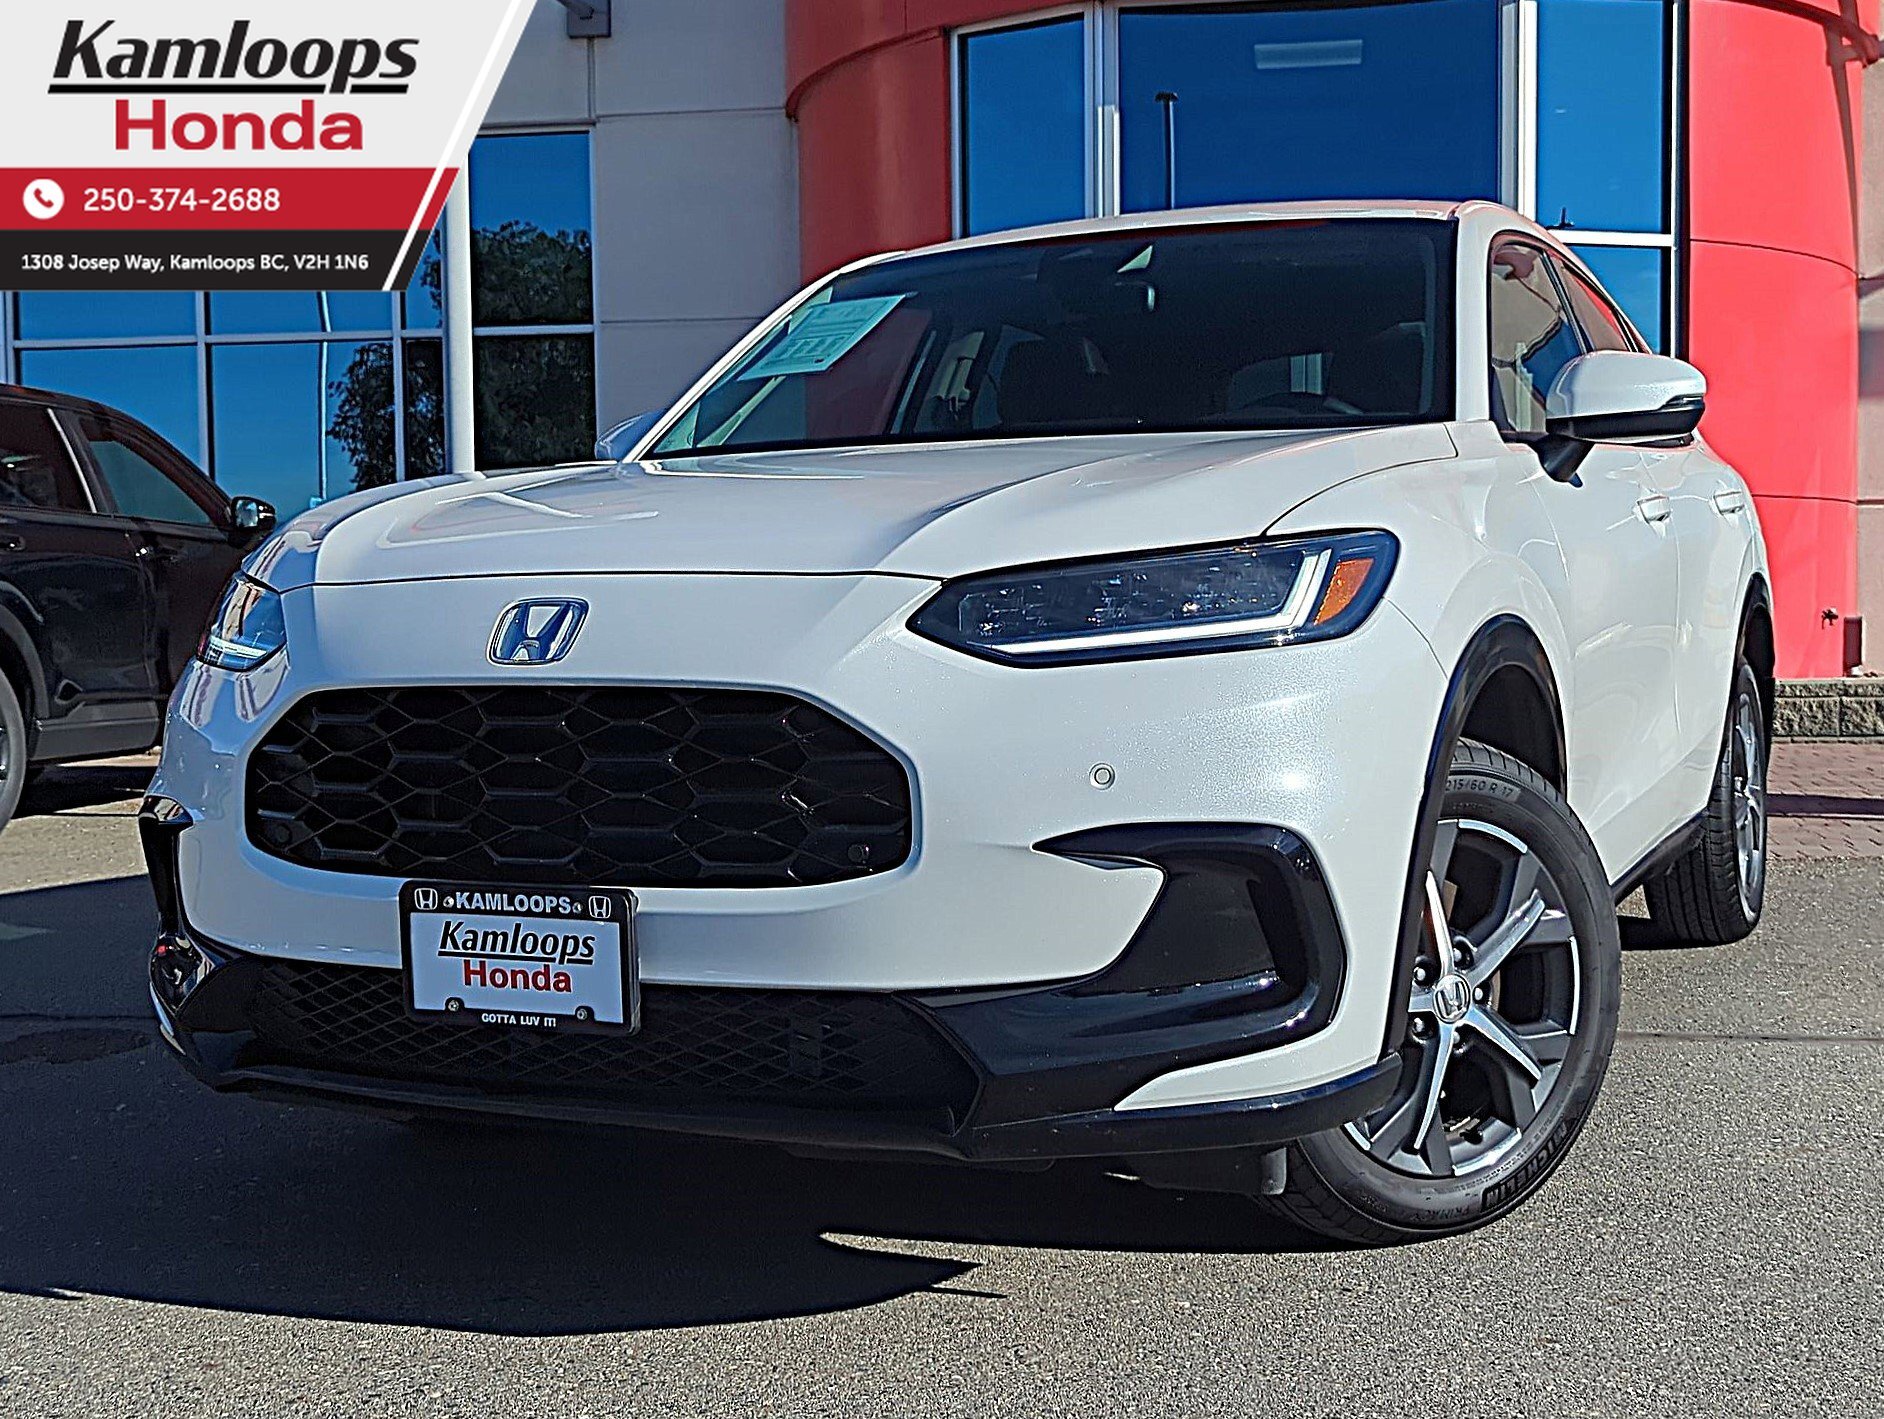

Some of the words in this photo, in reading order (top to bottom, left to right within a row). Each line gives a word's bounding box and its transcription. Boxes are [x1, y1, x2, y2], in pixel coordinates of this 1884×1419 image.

[1445, 778, 1487, 792] 215/60
[1489, 782, 1498, 794] R
[1501, 786, 1514, 798] 17
[455, 892, 571, 914] KAMLOOPS
[439, 920, 596, 965] Kamloops
[463, 960, 572, 993] Honda
[481, 1013, 517, 1025] GOTTA
[520, 1015, 540, 1026] LUV
[1483, 1121, 1568, 1207] MICHELIN
